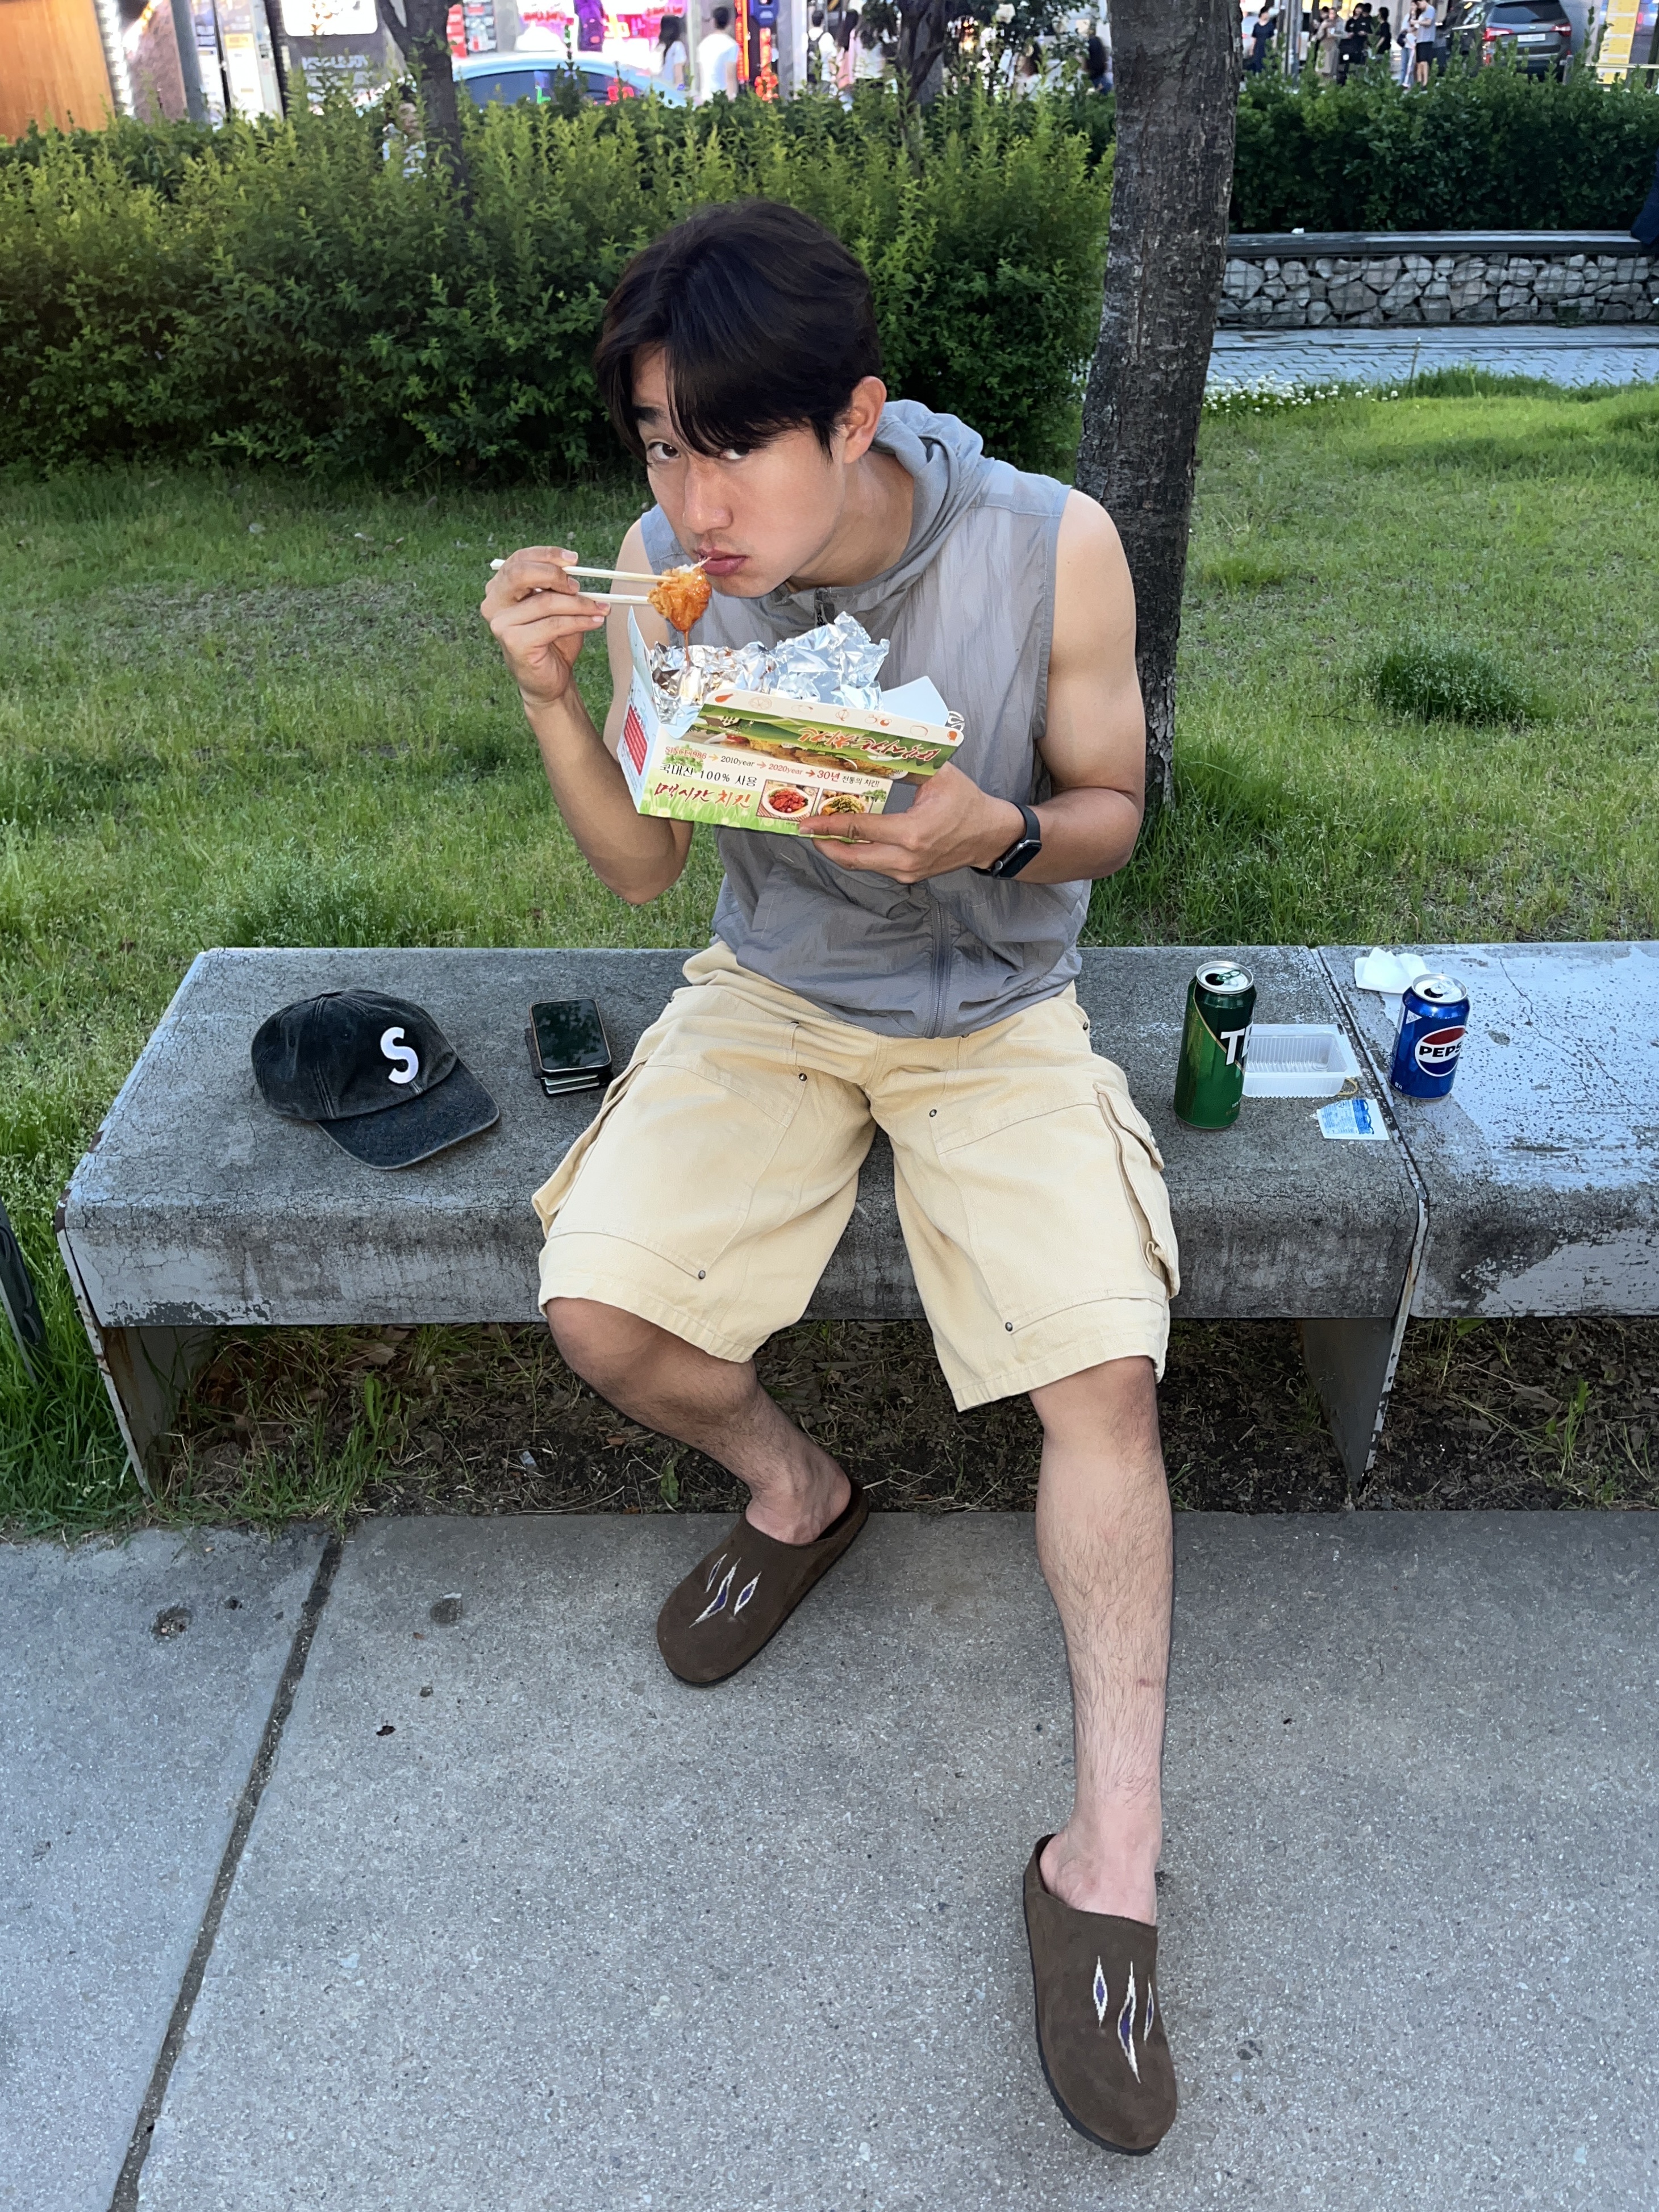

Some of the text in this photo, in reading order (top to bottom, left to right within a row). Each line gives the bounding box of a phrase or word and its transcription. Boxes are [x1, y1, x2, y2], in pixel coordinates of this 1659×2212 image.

[798, 727, 855, 749] 치킨
[665, 746, 707, 759] SINCE1986
[720, 756, 755, 767] 2010year
[769, 763, 803, 775] 2020year
[817, 770, 840, 782] 30년
[842, 775, 862, 785] 전통의
[701, 771, 730, 782] 100%
[735, 775, 757, 787] 사용
[715, 790, 751, 808] 치킨
[380, 1026, 419, 1084] S
[1419, 1041, 1462, 1058] PEPS
